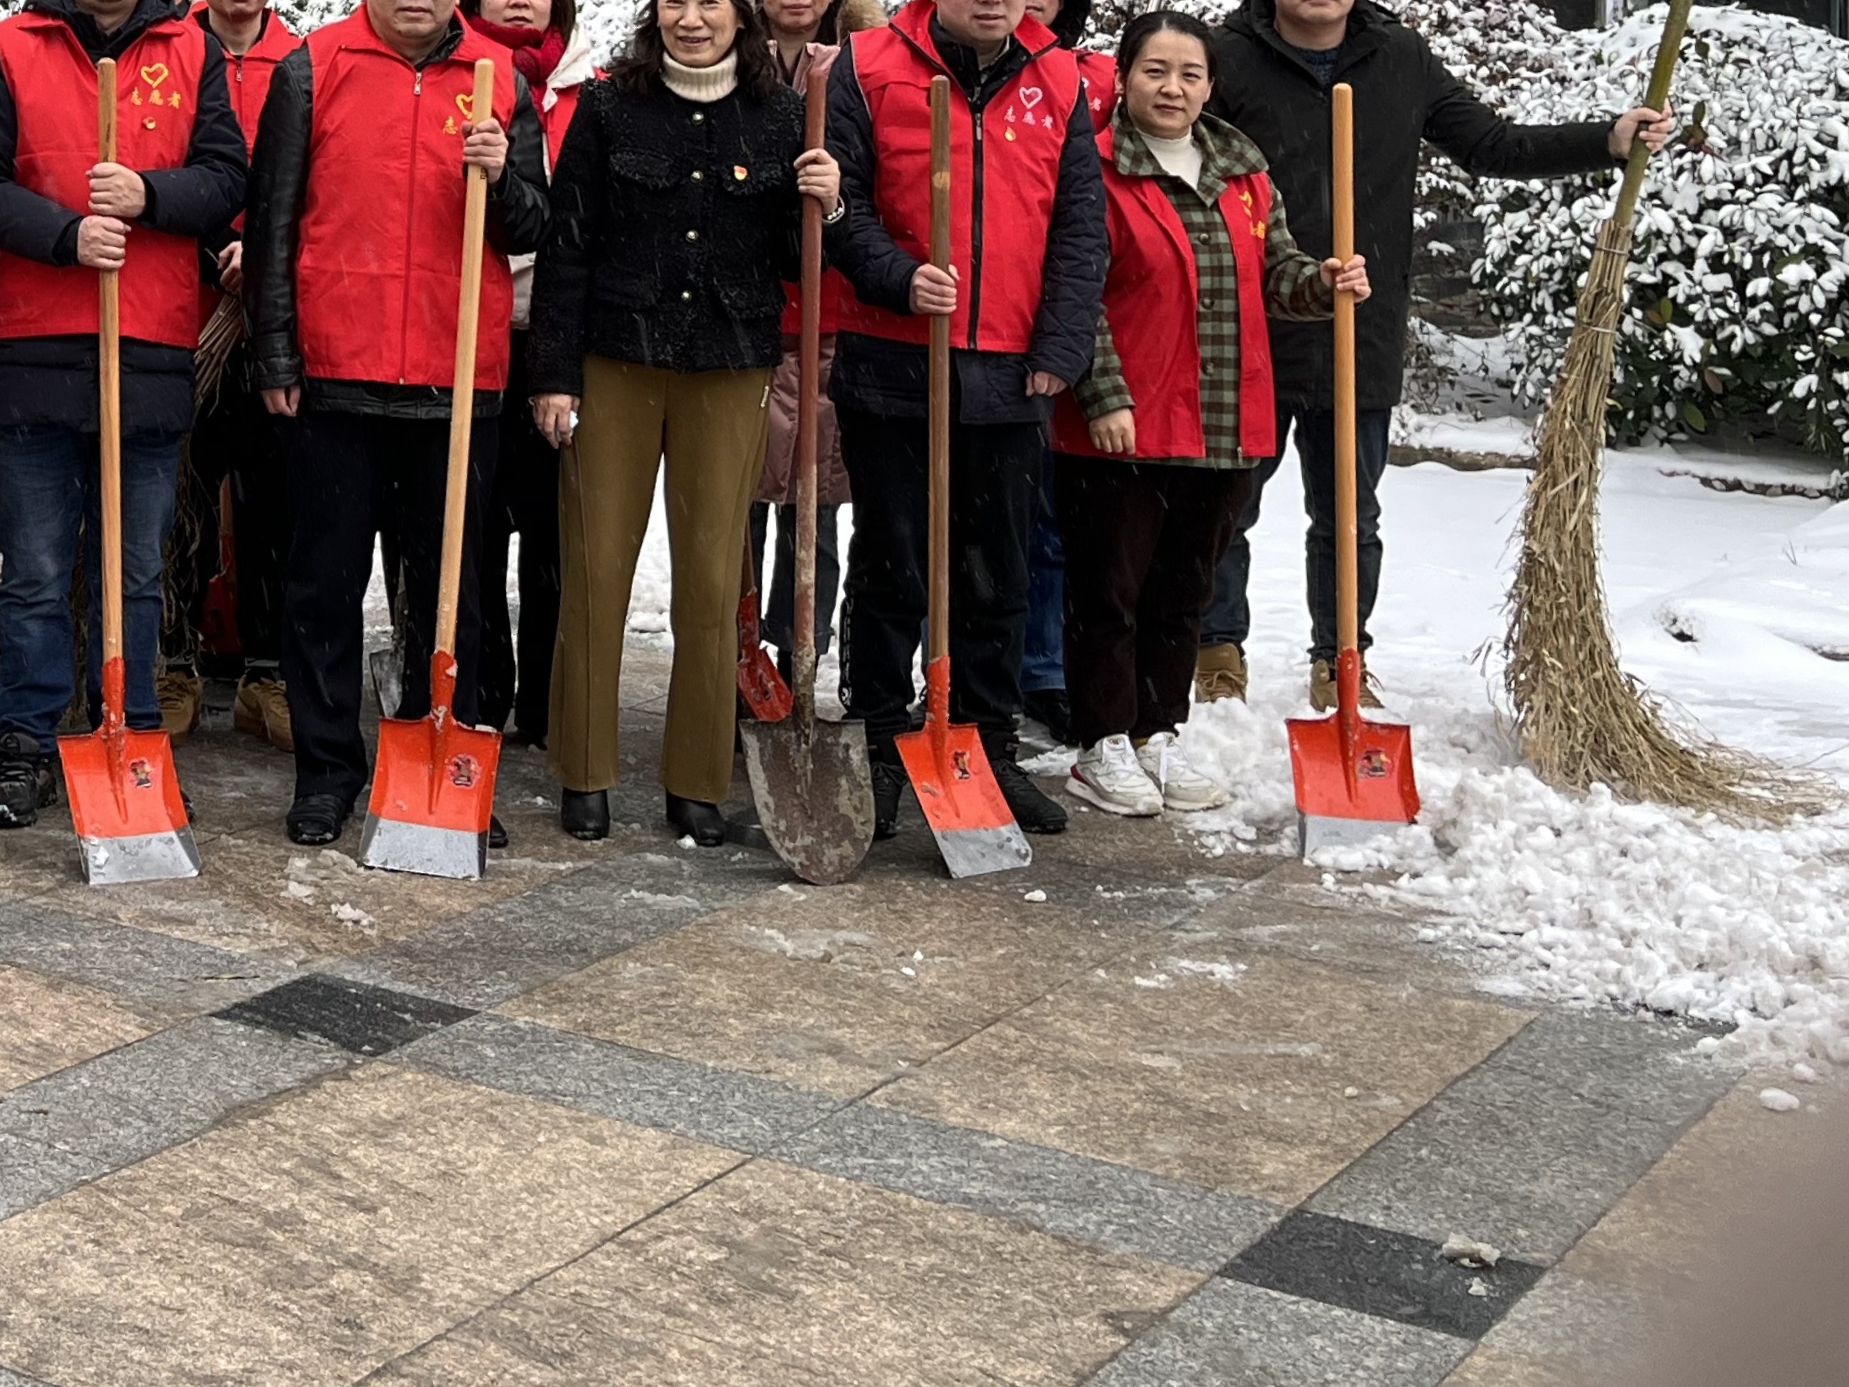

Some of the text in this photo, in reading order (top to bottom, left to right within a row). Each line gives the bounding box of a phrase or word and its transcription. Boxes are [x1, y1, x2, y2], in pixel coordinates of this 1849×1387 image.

[130, 86, 182, 110] 志愿者
[1003, 105, 1053, 131] 志愿者
